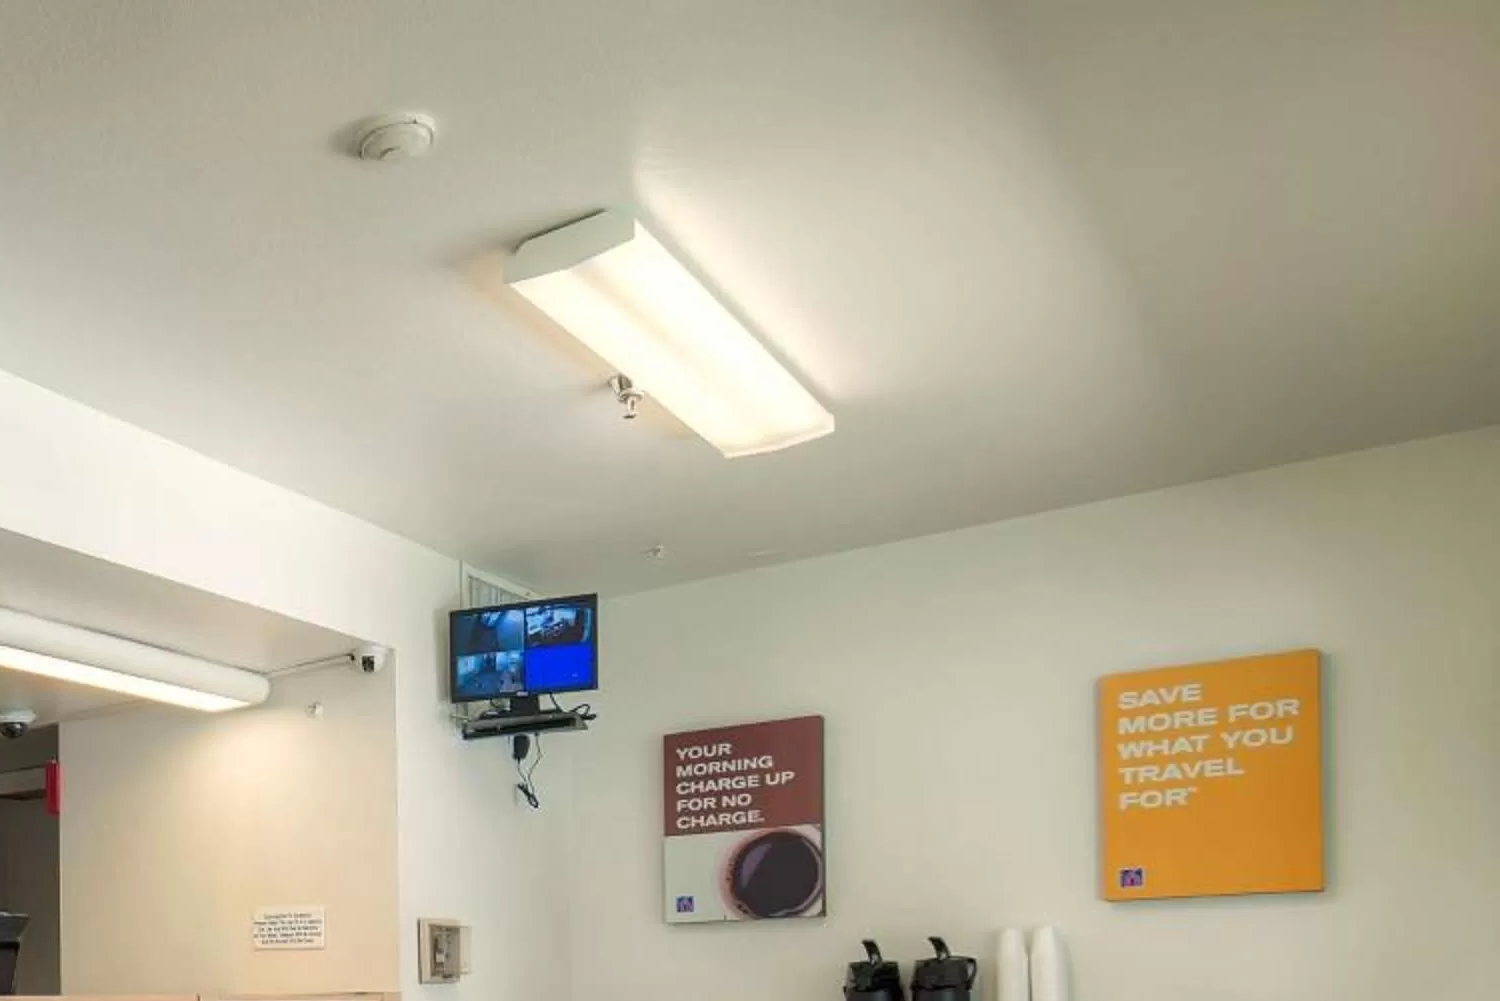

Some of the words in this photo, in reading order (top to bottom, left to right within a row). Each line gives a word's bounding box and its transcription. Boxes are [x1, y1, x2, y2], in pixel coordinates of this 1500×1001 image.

[1118, 683, 1201, 710] SAVE
[1118, 707, 1218, 735] MORE
[1227, 699, 1300, 724] FOR
[676, 743, 732, 761] YOUR
[1118, 734, 1210, 760] WHAT
[1220, 725, 1293, 749] YOU
[676, 755, 773, 778] MORNING
[1118, 758, 1245, 785] TRAVEL
[676, 774, 760, 795] CHARGE
[765, 771, 796, 786] UP
[677, 797, 717, 813] FOR
[722, 793, 752, 808] NO
